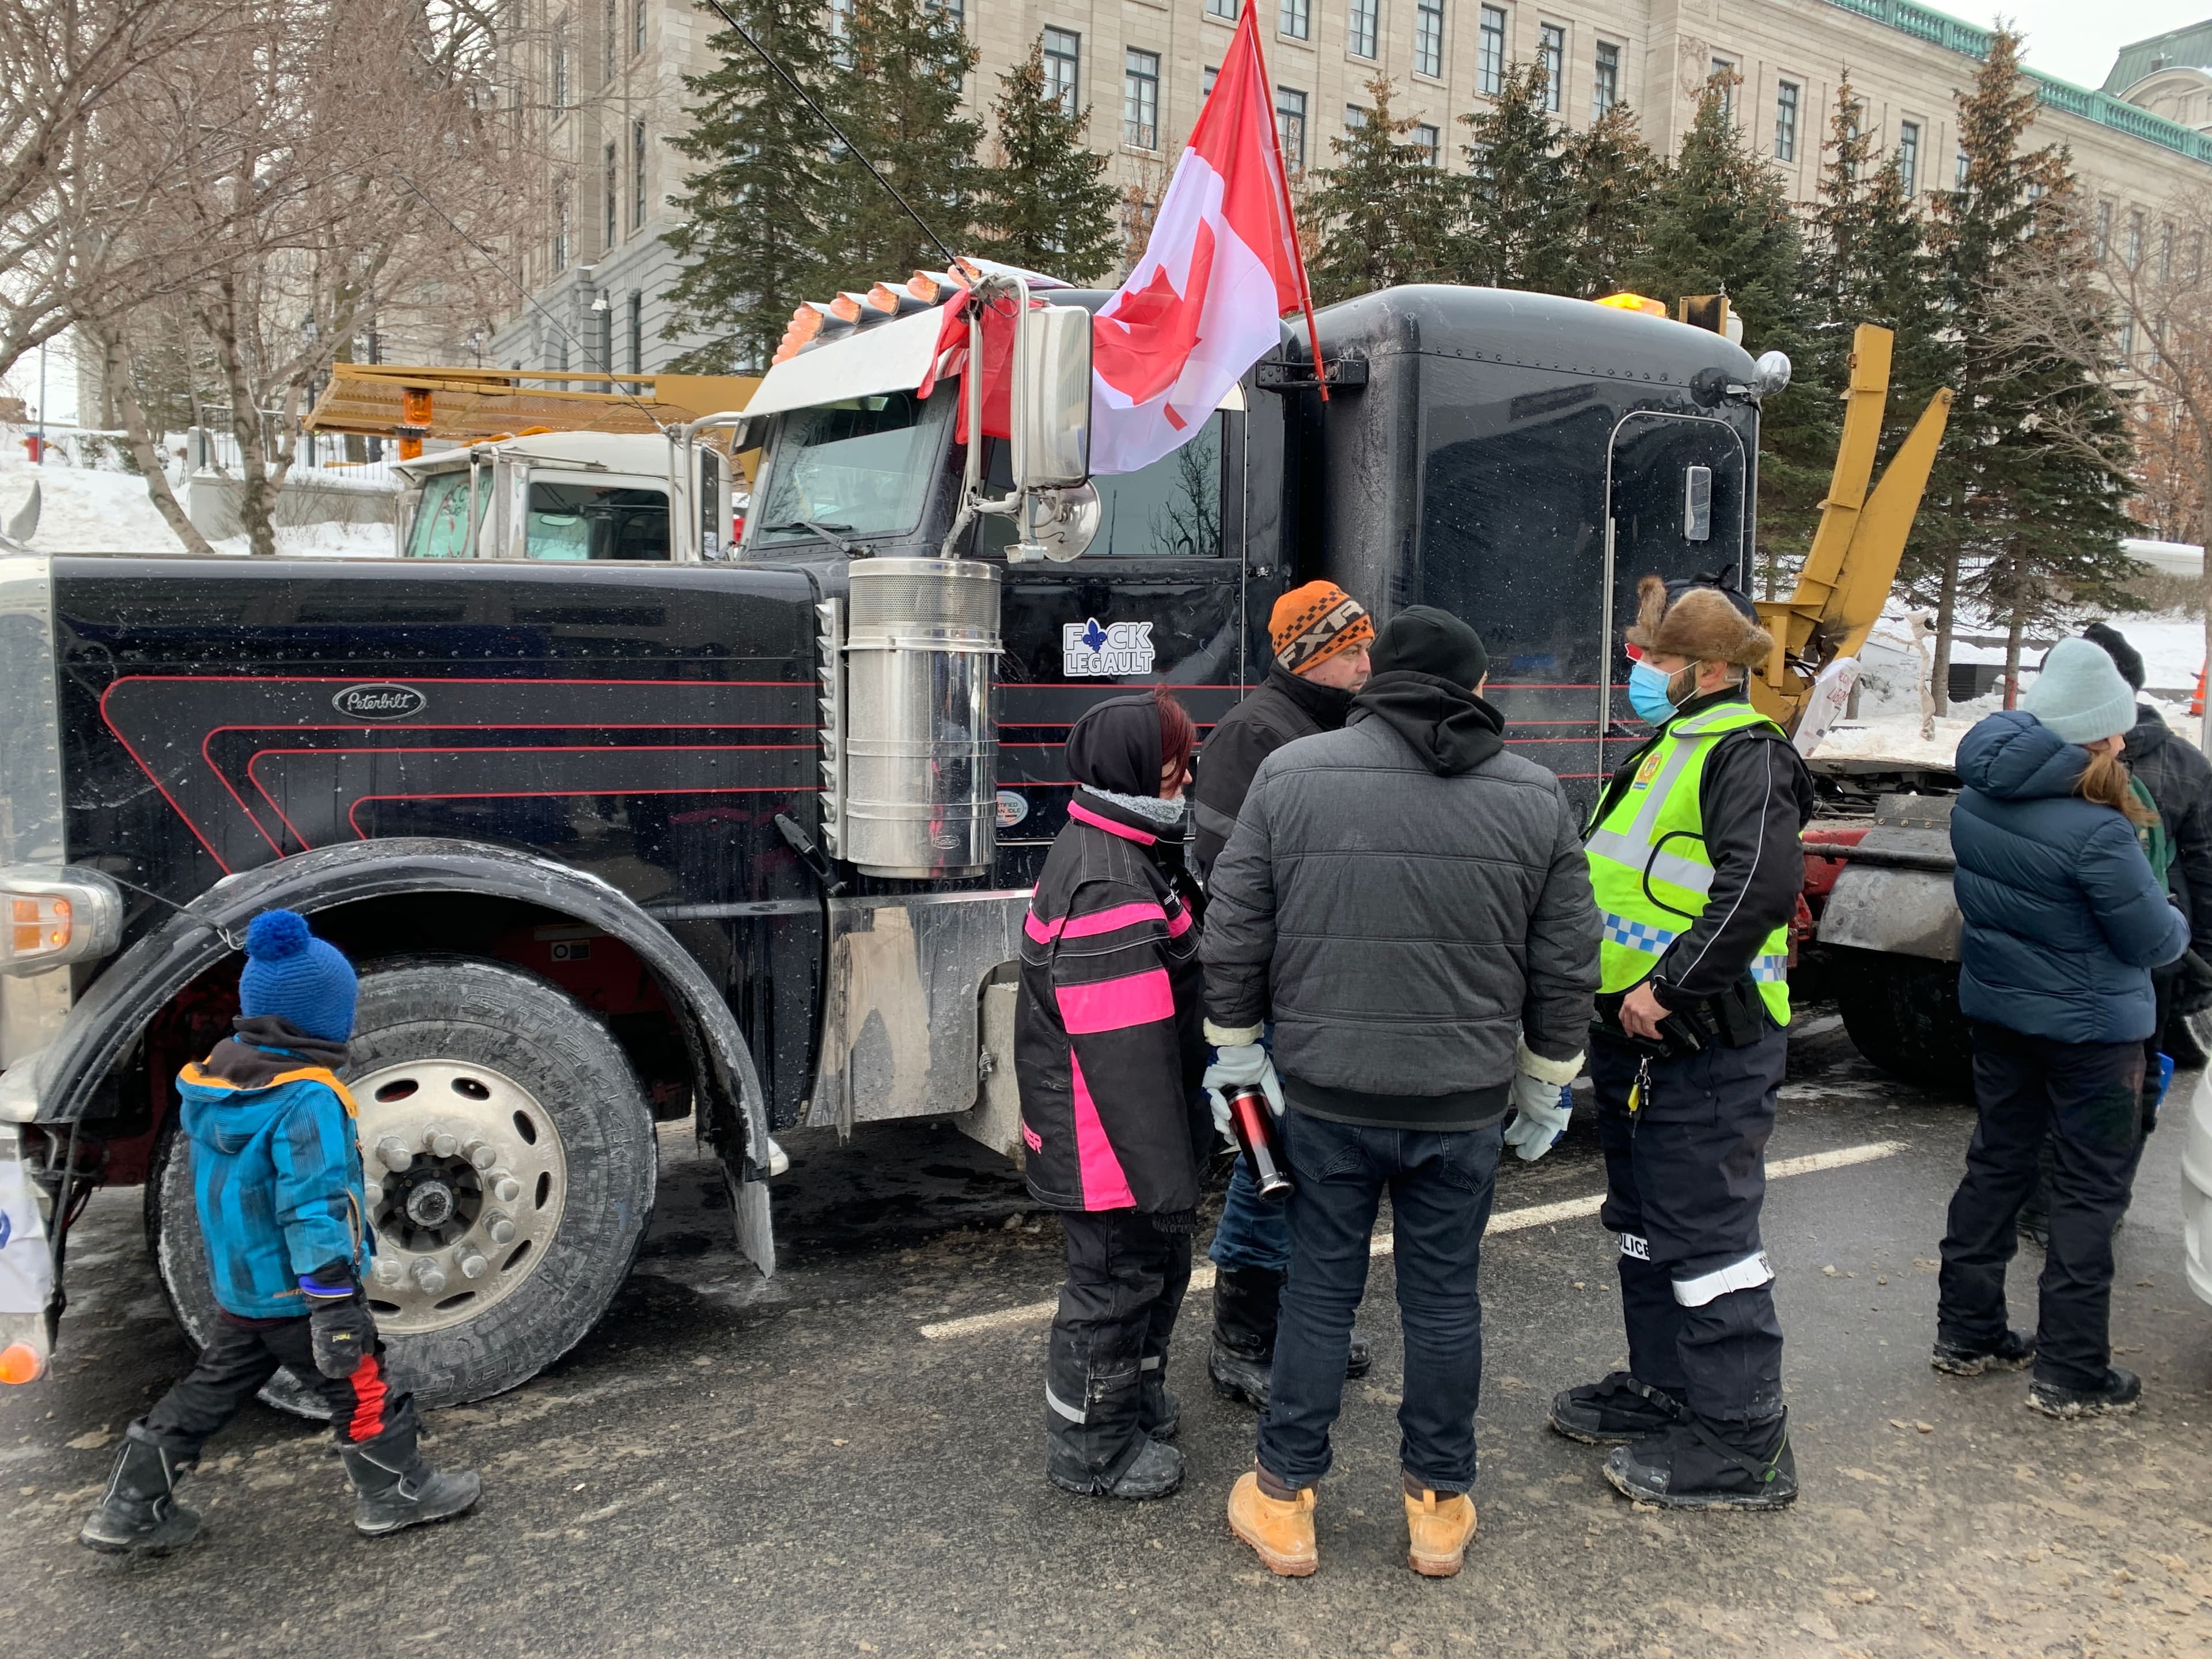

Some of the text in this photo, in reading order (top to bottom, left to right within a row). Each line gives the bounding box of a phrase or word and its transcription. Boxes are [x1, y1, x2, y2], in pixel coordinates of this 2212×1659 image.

[1066, 622, 1152, 650] FCK
[1278, 600, 1364, 669] FXR
[1066, 652, 1152, 673] LEGAULT
[347, 692, 414, 711] Peterbilt
[1619, 1233, 1650, 1257] OLICE
